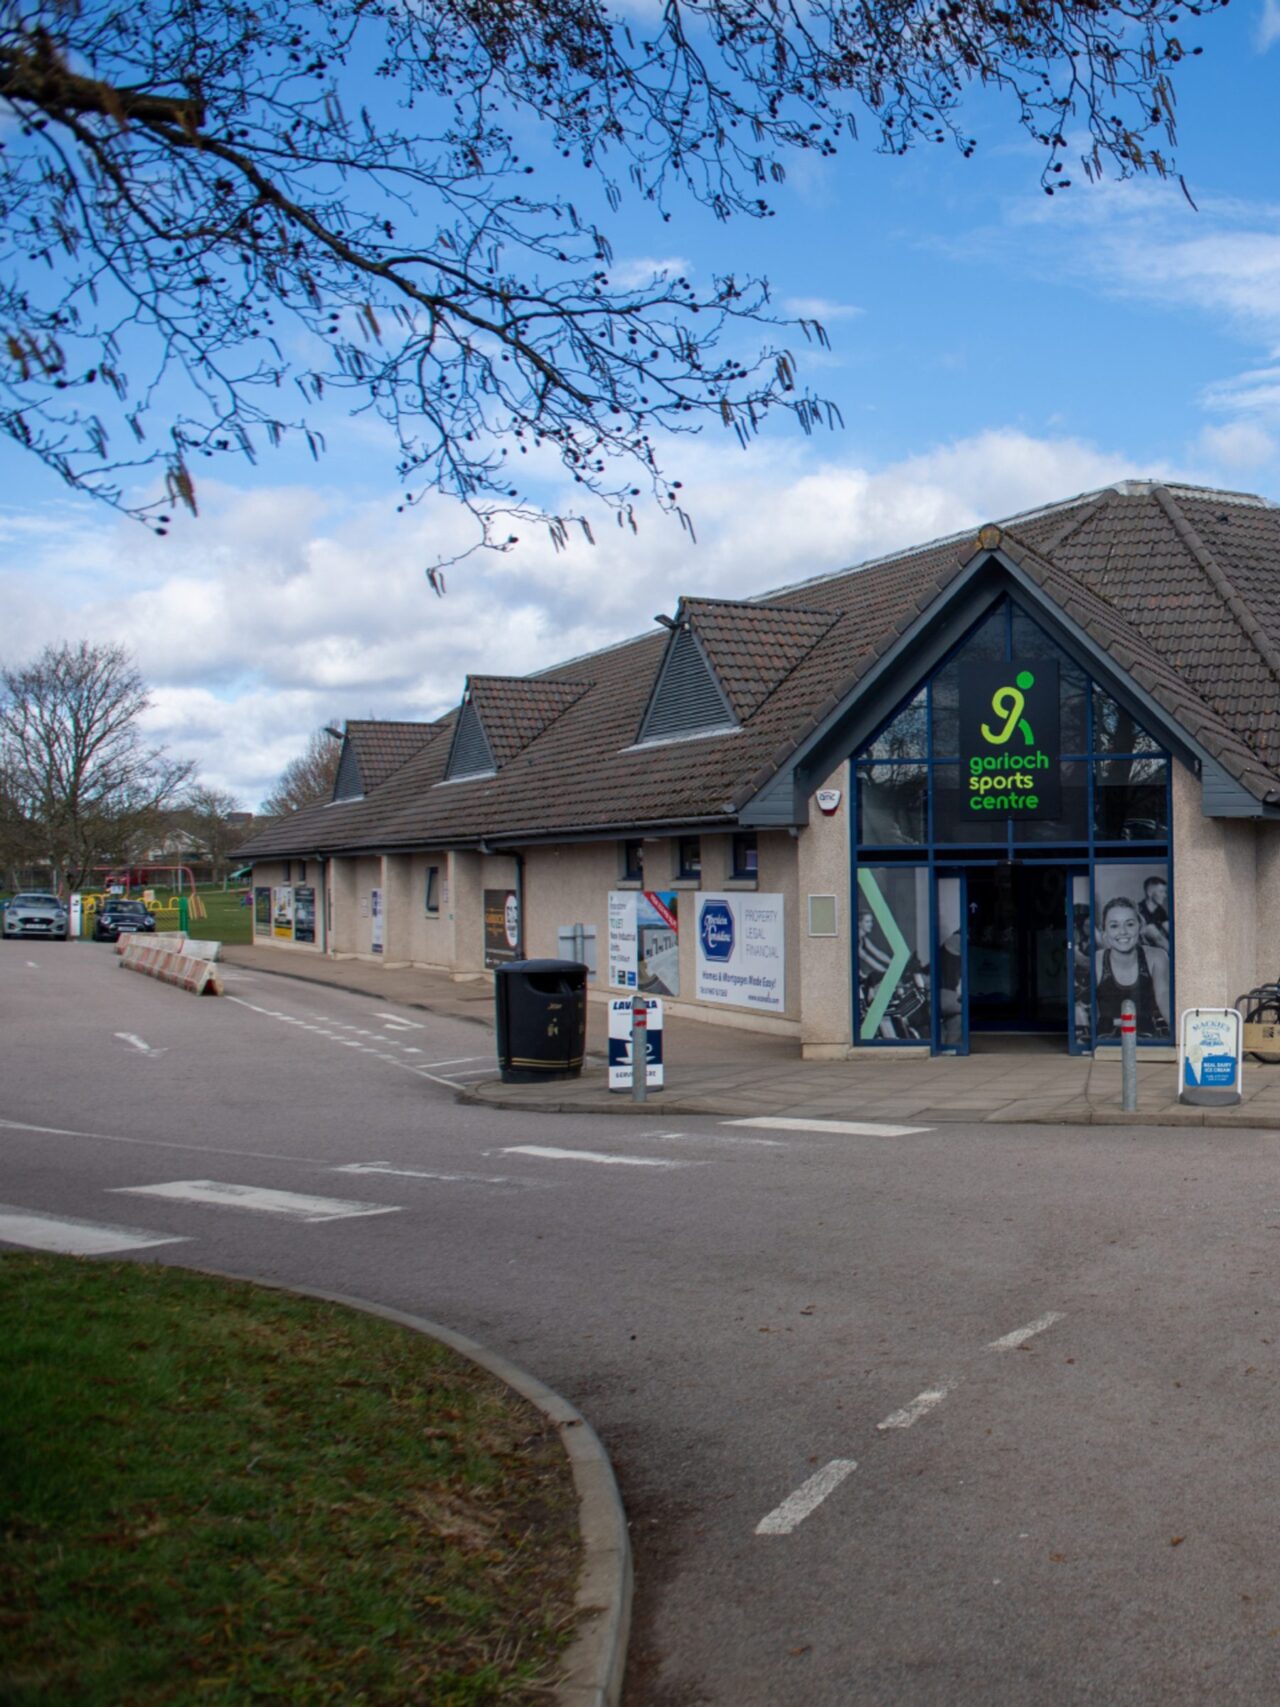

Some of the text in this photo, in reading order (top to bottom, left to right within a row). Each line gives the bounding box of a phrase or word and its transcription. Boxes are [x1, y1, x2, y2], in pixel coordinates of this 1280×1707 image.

[969, 750, 1049, 775] garioch
[969, 772, 1034, 795] sports
[969, 792, 1039, 810] centre
[744, 910, 777, 922] PROPERTY
[745, 927, 766, 940] LEGAL
[745, 944, 779, 958] FINANCIAL
